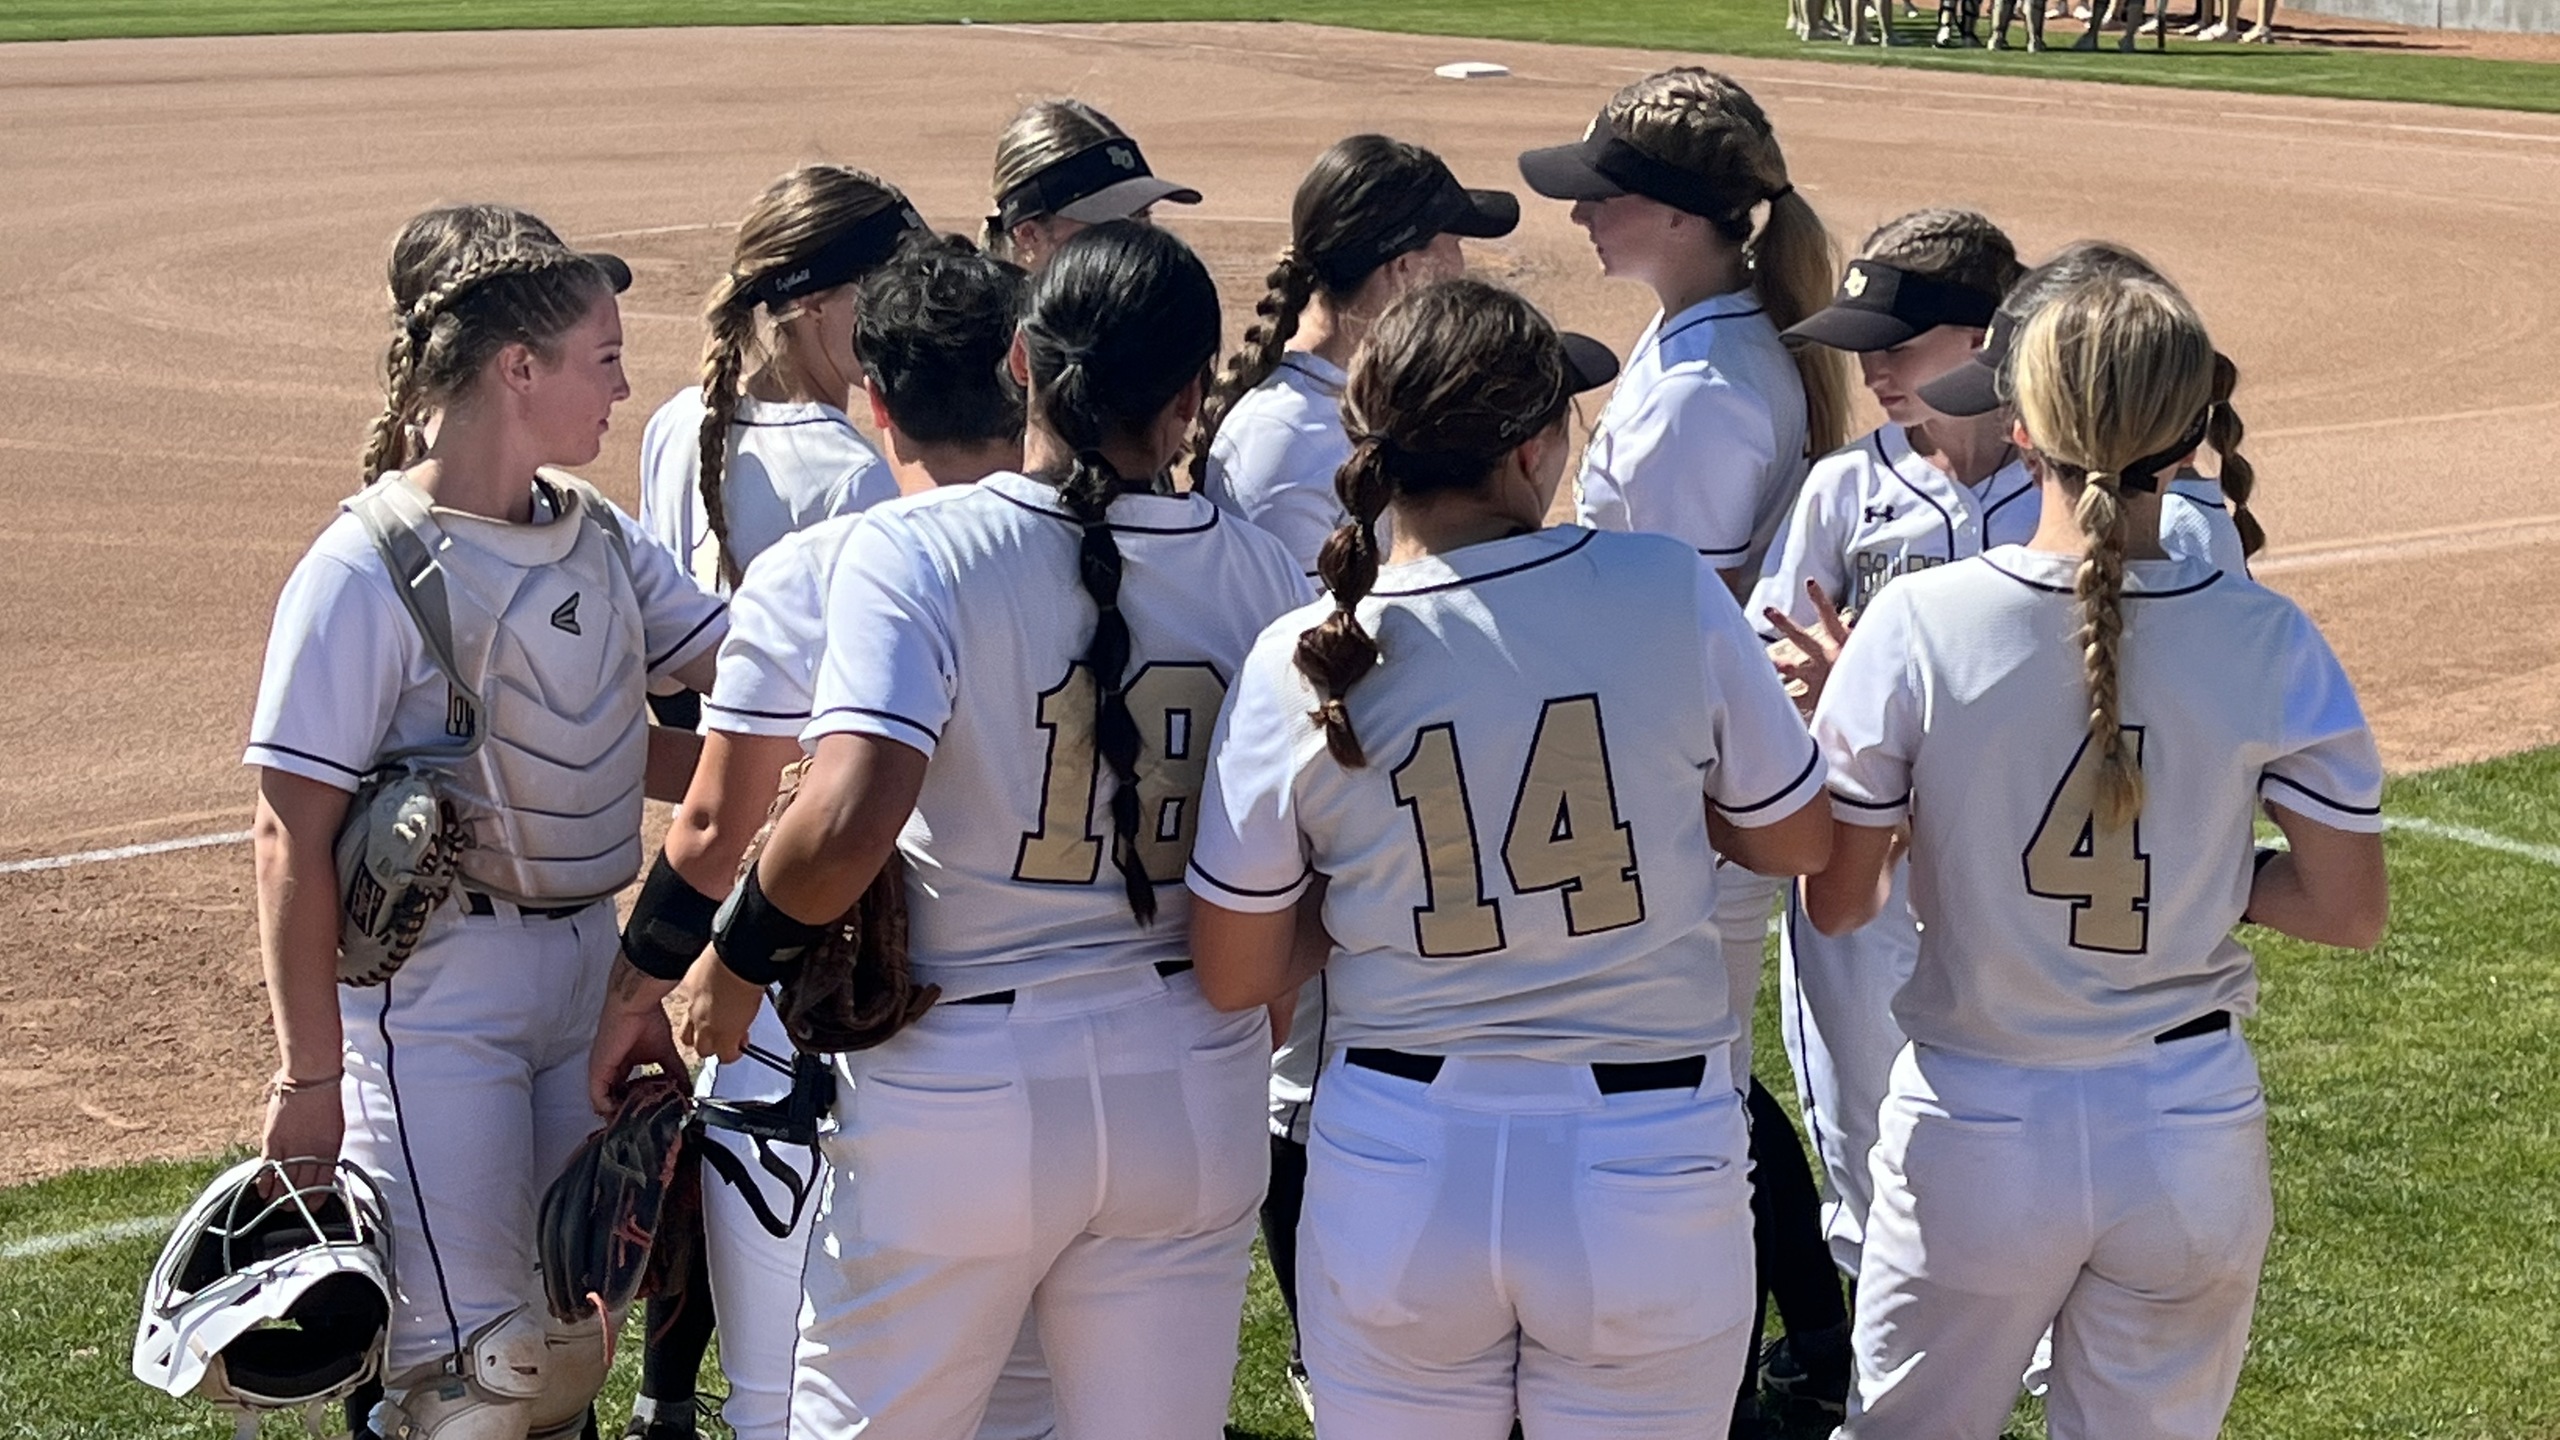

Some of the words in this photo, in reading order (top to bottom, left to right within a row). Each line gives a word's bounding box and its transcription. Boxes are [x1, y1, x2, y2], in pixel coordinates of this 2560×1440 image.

[1011, 660, 1229, 885] 18
[1389, 692, 1645, 958] 14
[2021, 724, 2150, 954] 4
